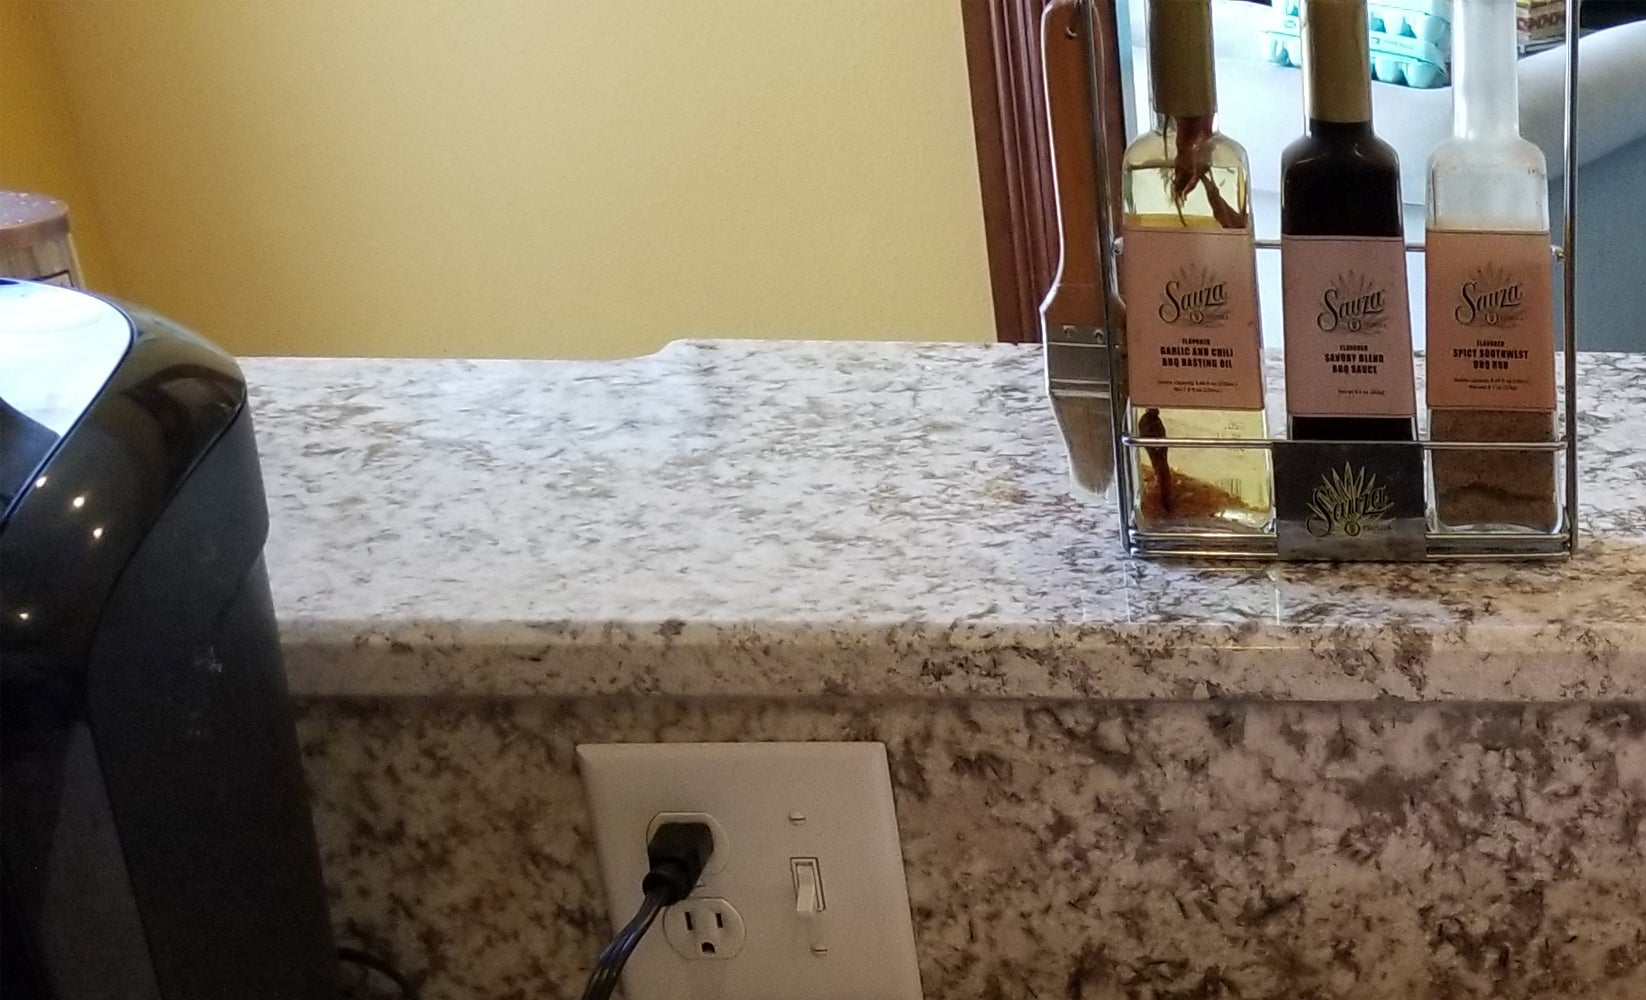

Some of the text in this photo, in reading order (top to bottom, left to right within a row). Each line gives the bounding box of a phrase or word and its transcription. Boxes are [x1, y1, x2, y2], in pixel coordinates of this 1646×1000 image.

[1158, 281, 1228, 324] Sauza
[1455, 282, 1524, 325] Sauza
[1317, 289, 1386, 332] Sauza
[1160, 346, 1234, 358] GARLIC AND CHILI
[1453, 348, 1529, 359] SPICY SOUTHWEST
[1162, 358, 1233, 369] BBQ BASTING OIL
[1324, 353, 1384, 363] SAVORY BLEND
[1332, 364, 1378, 374] BBQ SAUCE
[1473, 360, 1509, 370] BBQ RUB
[1306, 486, 1390, 538] Sauza
